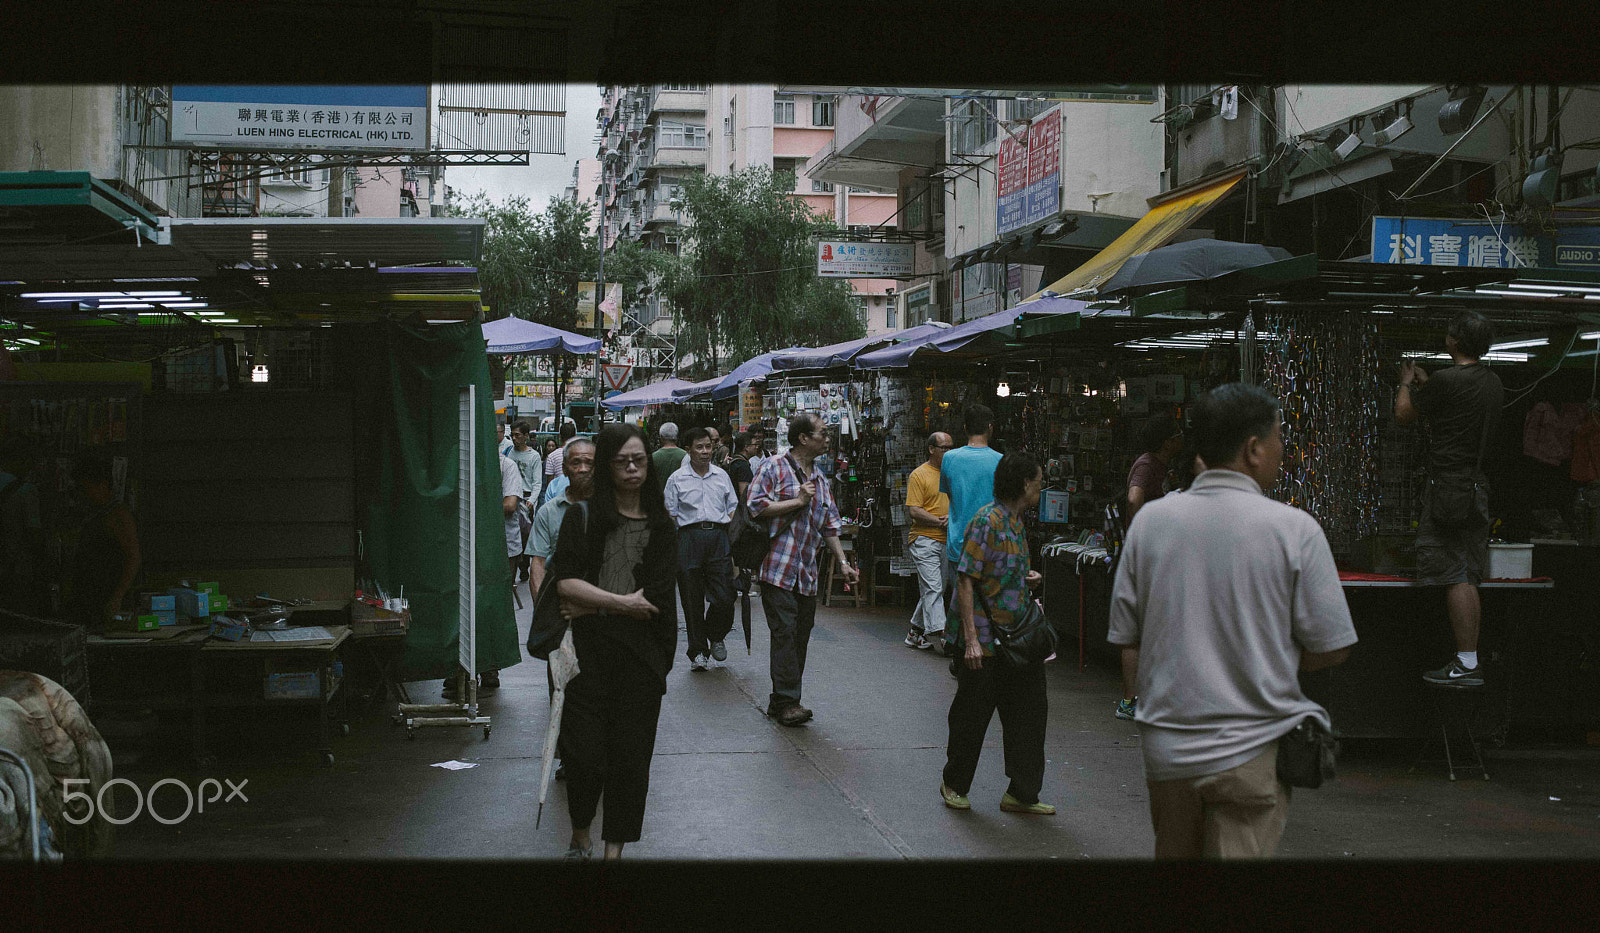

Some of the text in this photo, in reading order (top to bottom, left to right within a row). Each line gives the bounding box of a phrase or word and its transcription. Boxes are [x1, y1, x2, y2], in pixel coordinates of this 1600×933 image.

[237, 127, 413, 142] LUEN HING ELECTRICAL (HK) LTD.
